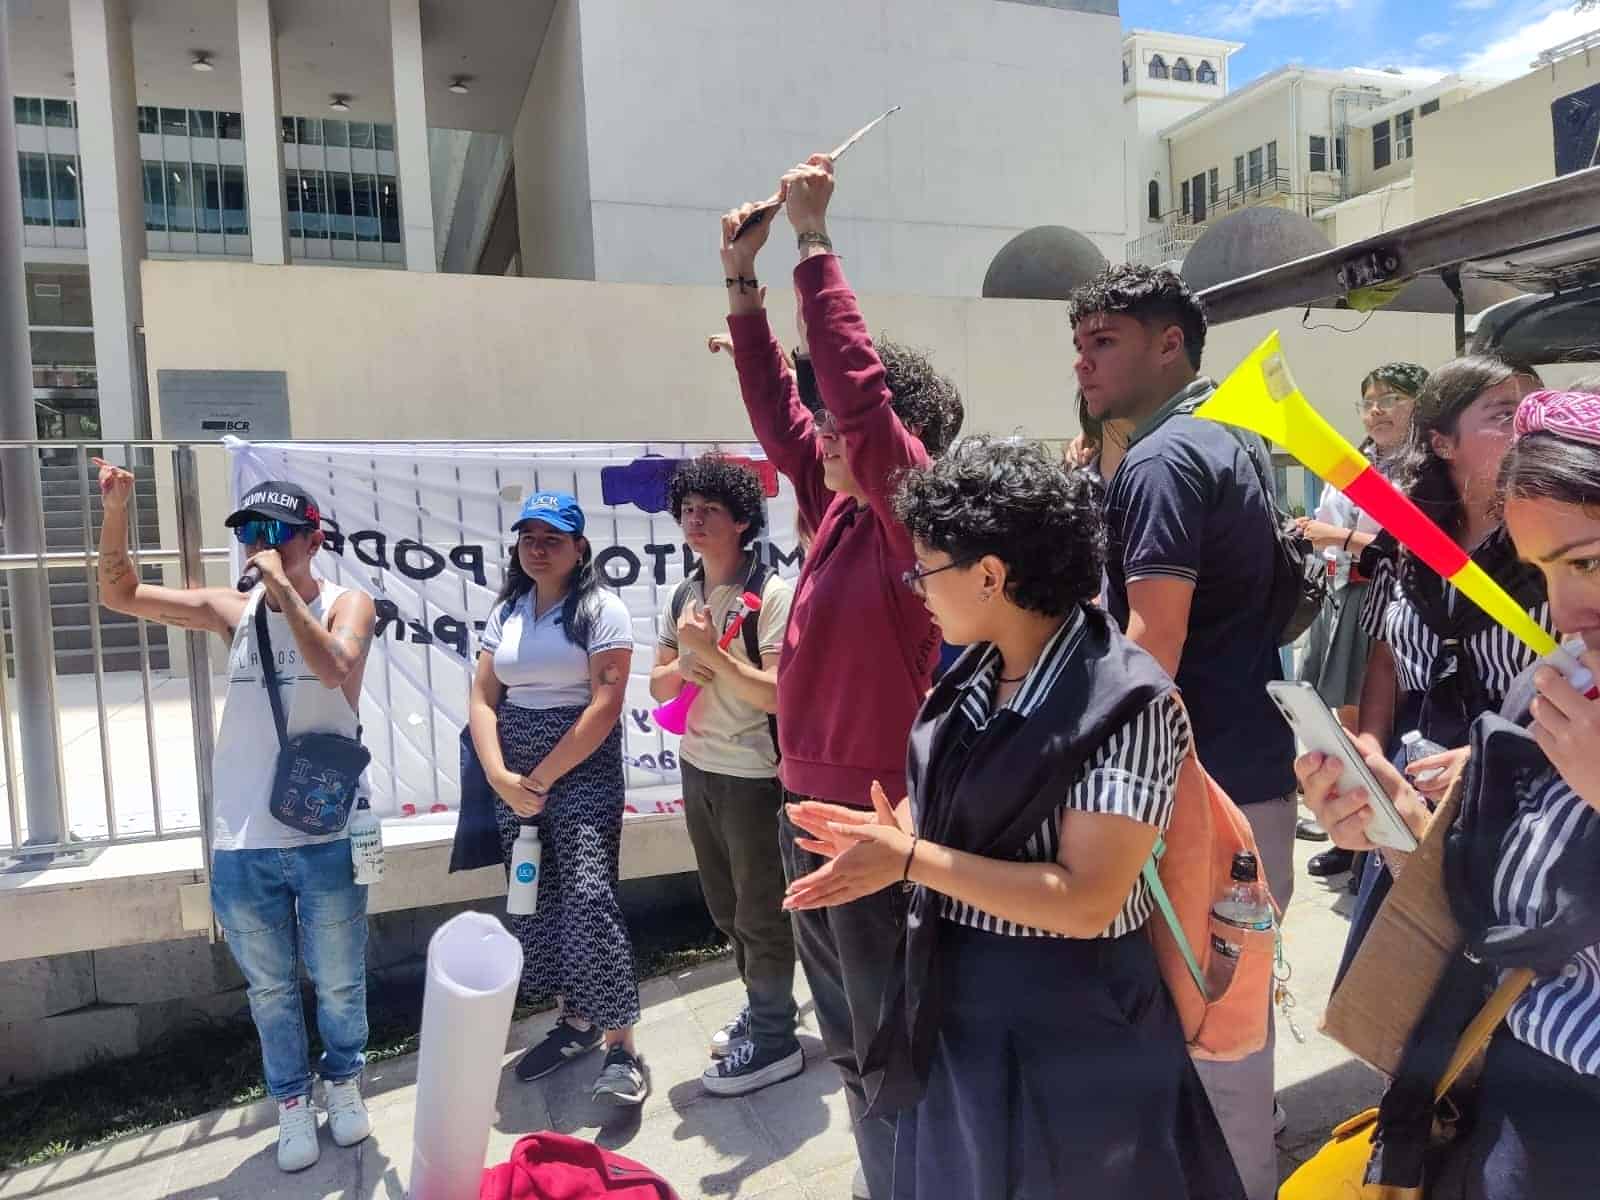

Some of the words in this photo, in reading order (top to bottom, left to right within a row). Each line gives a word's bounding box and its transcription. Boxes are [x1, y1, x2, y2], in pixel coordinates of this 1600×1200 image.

[226, 420, 250, 433] BCR
[267, 491, 298, 510] KLEIN
[531, 495, 559, 506] UCR
